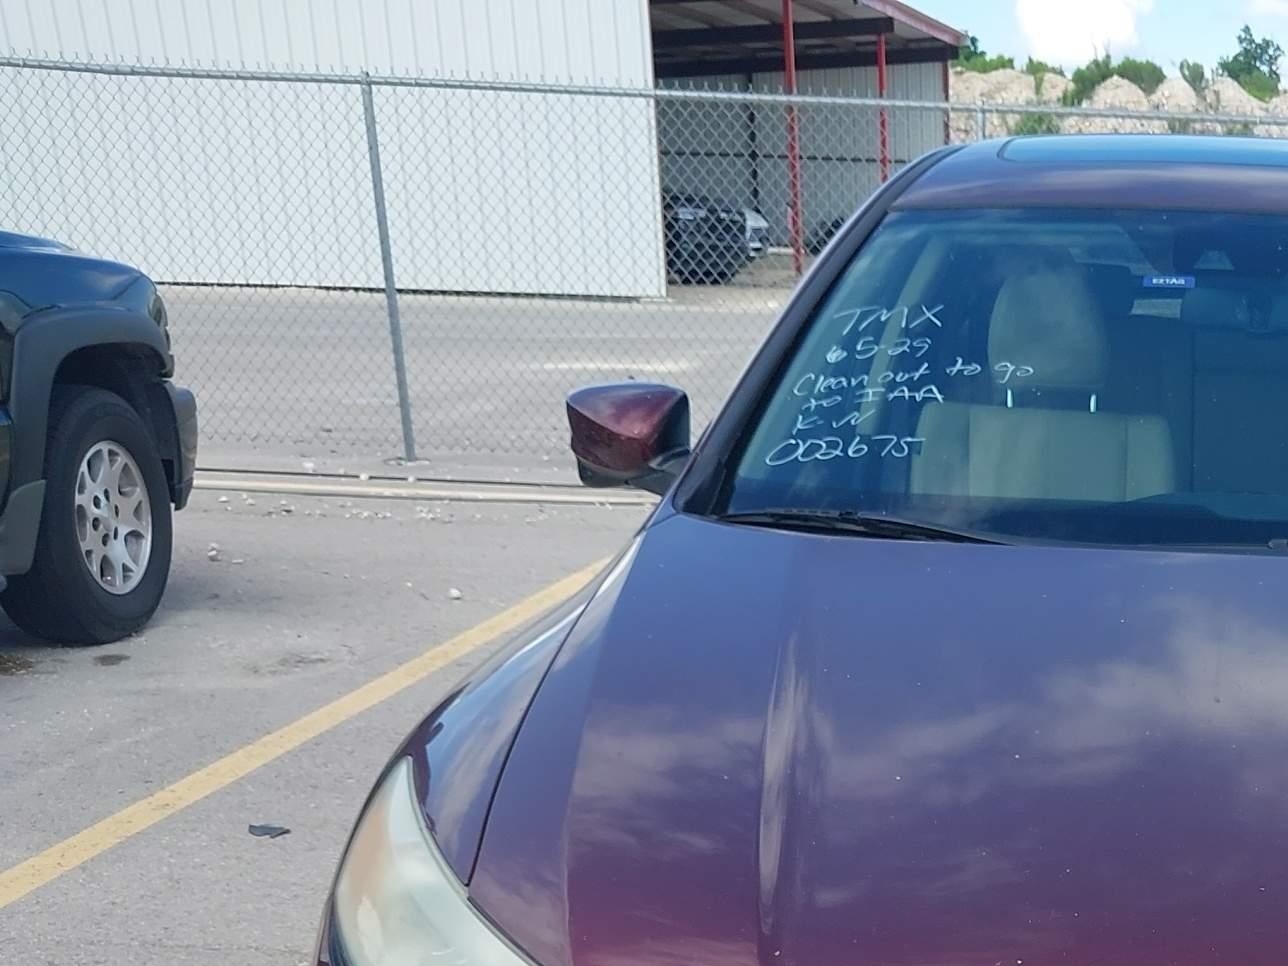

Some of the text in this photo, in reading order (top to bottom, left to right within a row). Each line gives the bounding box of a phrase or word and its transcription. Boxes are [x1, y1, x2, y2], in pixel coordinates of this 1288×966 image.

[792, 372, 869, 397] Clean
[877, 361, 929, 384] out
[945, 355, 982, 376] to
[765, 435, 926, 467] 002675
